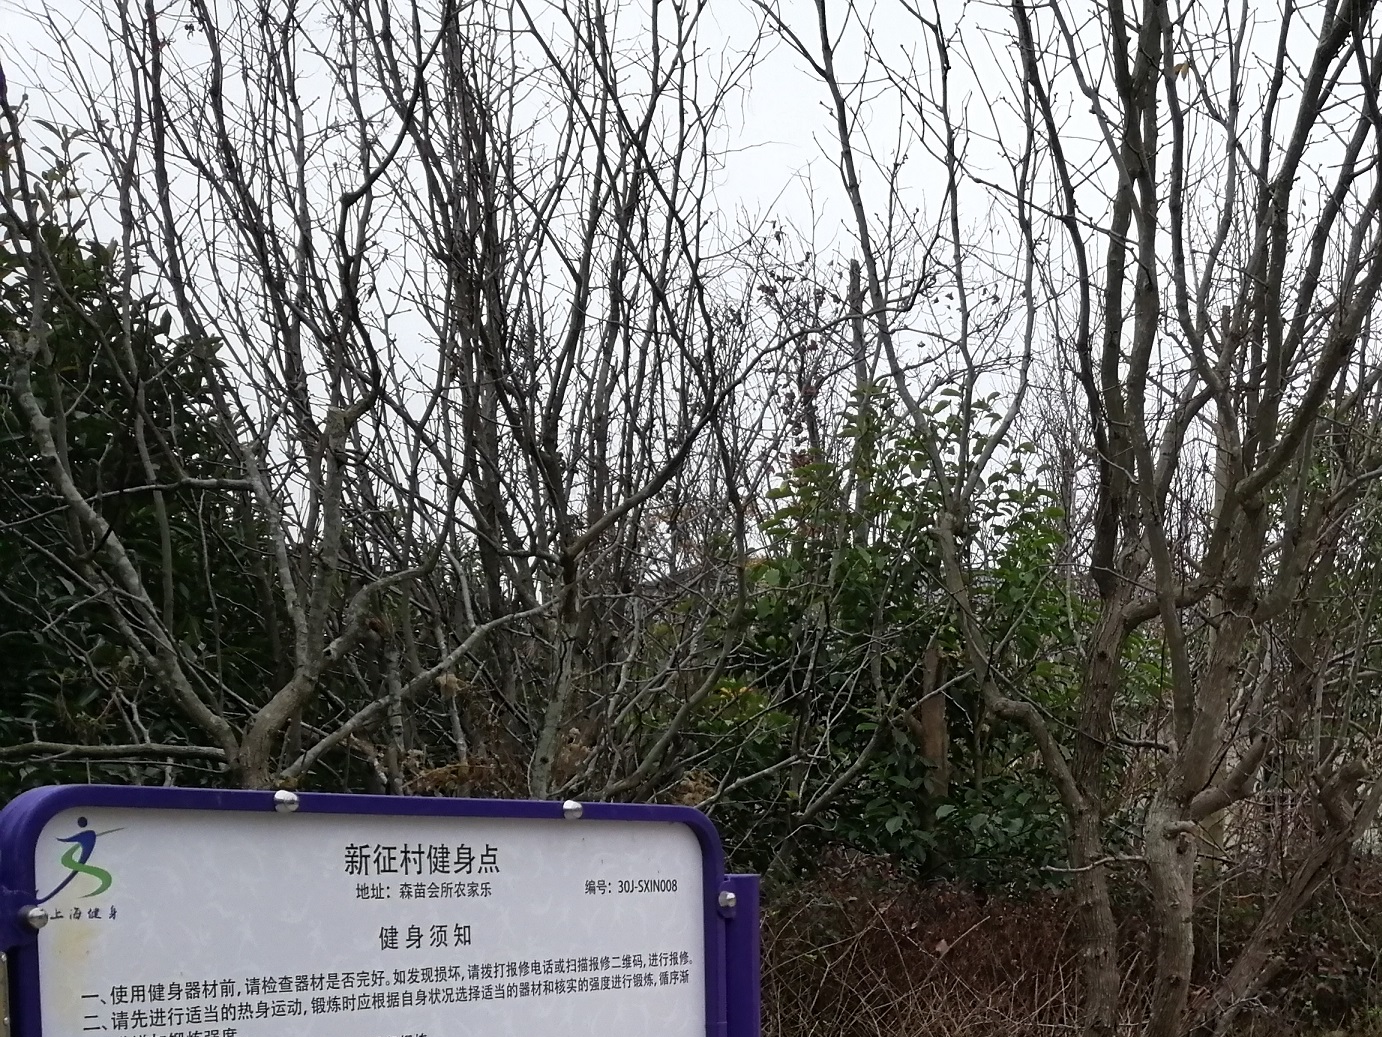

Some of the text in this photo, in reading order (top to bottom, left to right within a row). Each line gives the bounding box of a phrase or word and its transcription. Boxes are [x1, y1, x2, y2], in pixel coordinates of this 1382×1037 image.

[344, 843, 500, 876] 新征村健身点
[379, 923, 472, 950] 健身须知
